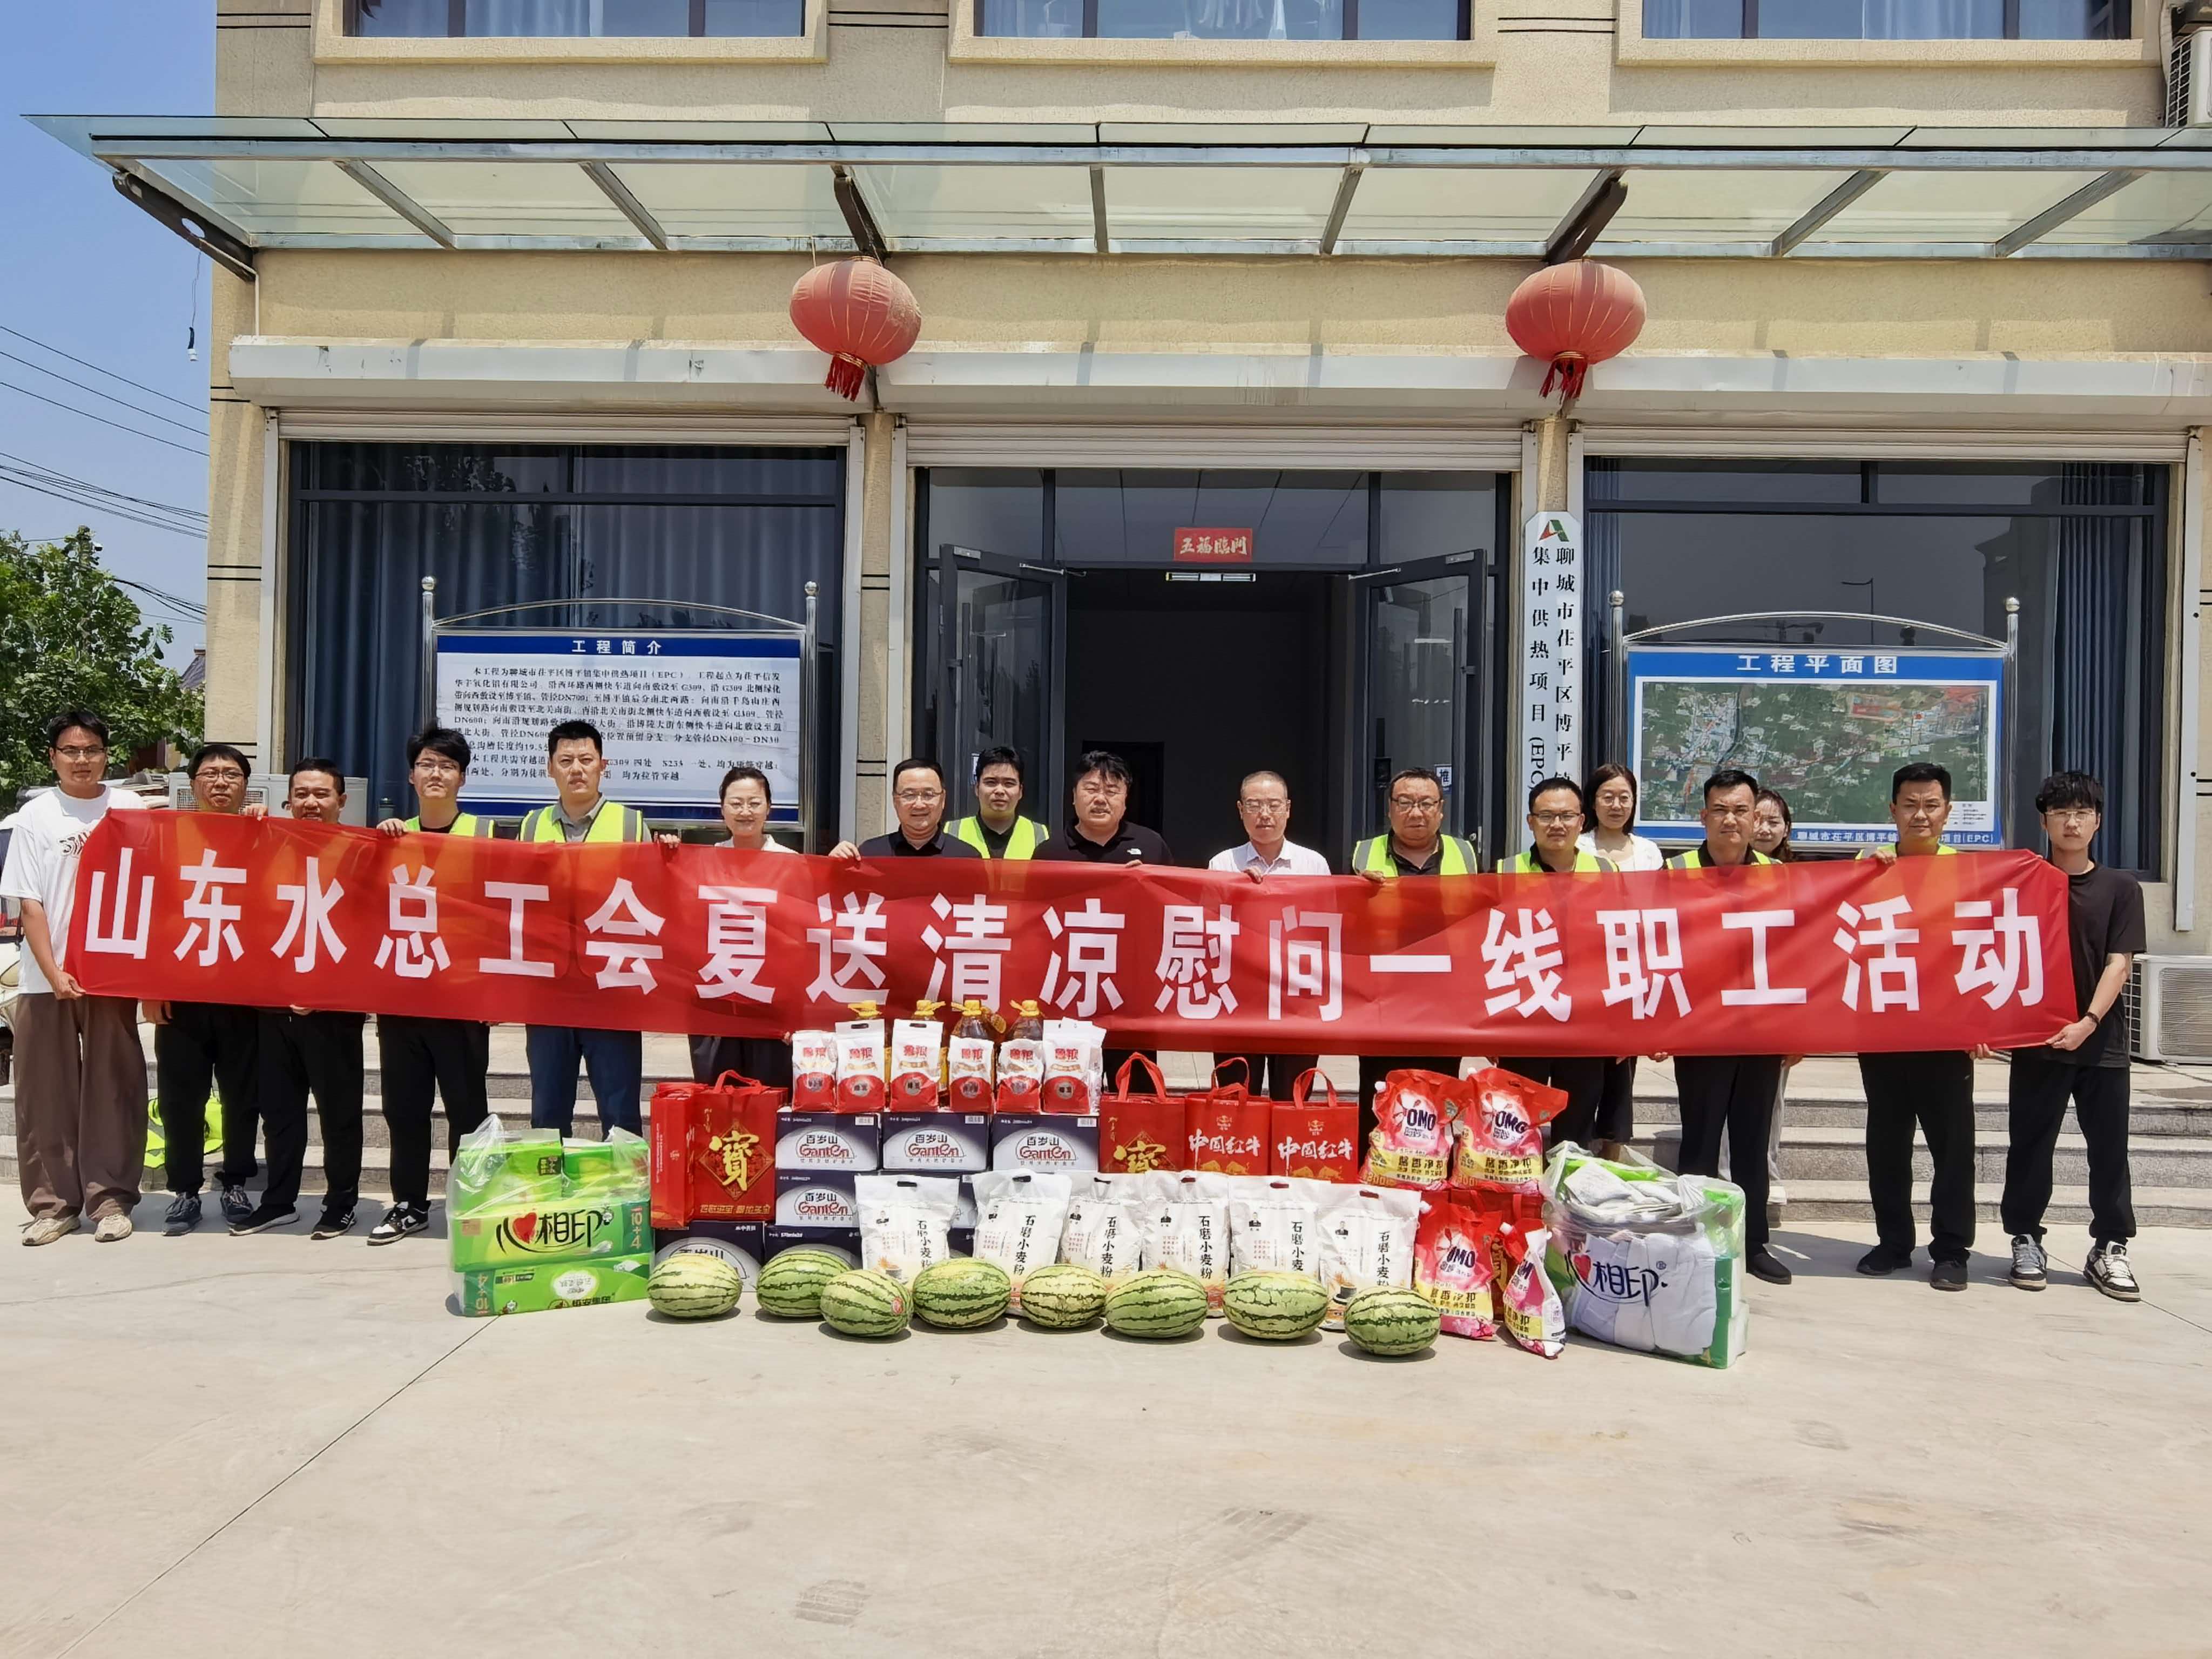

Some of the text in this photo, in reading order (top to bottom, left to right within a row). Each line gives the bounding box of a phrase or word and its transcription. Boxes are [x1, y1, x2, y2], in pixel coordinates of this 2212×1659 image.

[571, 639, 662, 655] 工程简介
[1736, 655, 1899, 675] 工程平面图
[85, 847, 2045, 1022] 山东水总工会夏送清凉慰问一线职工活动
[1407, 1108, 1437, 1131] OMO
[806, 1135, 838, 1144] 百岁山
[915, 1134, 948, 1143] 百岁山
[1027, 1136, 1060, 1146] 百岁山
[1189, 1129, 1262, 1170] 中国红牛
[1278, 1136, 1353, 1176] 中国红牛
[805, 1192, 837, 1202] 百岁山
[1100, 1216, 1117, 1278] 石磨小麦粉
[1198, 1215, 1213, 1279] 石磨小麦粉
[1446, 1246, 1476, 1269] OMO
